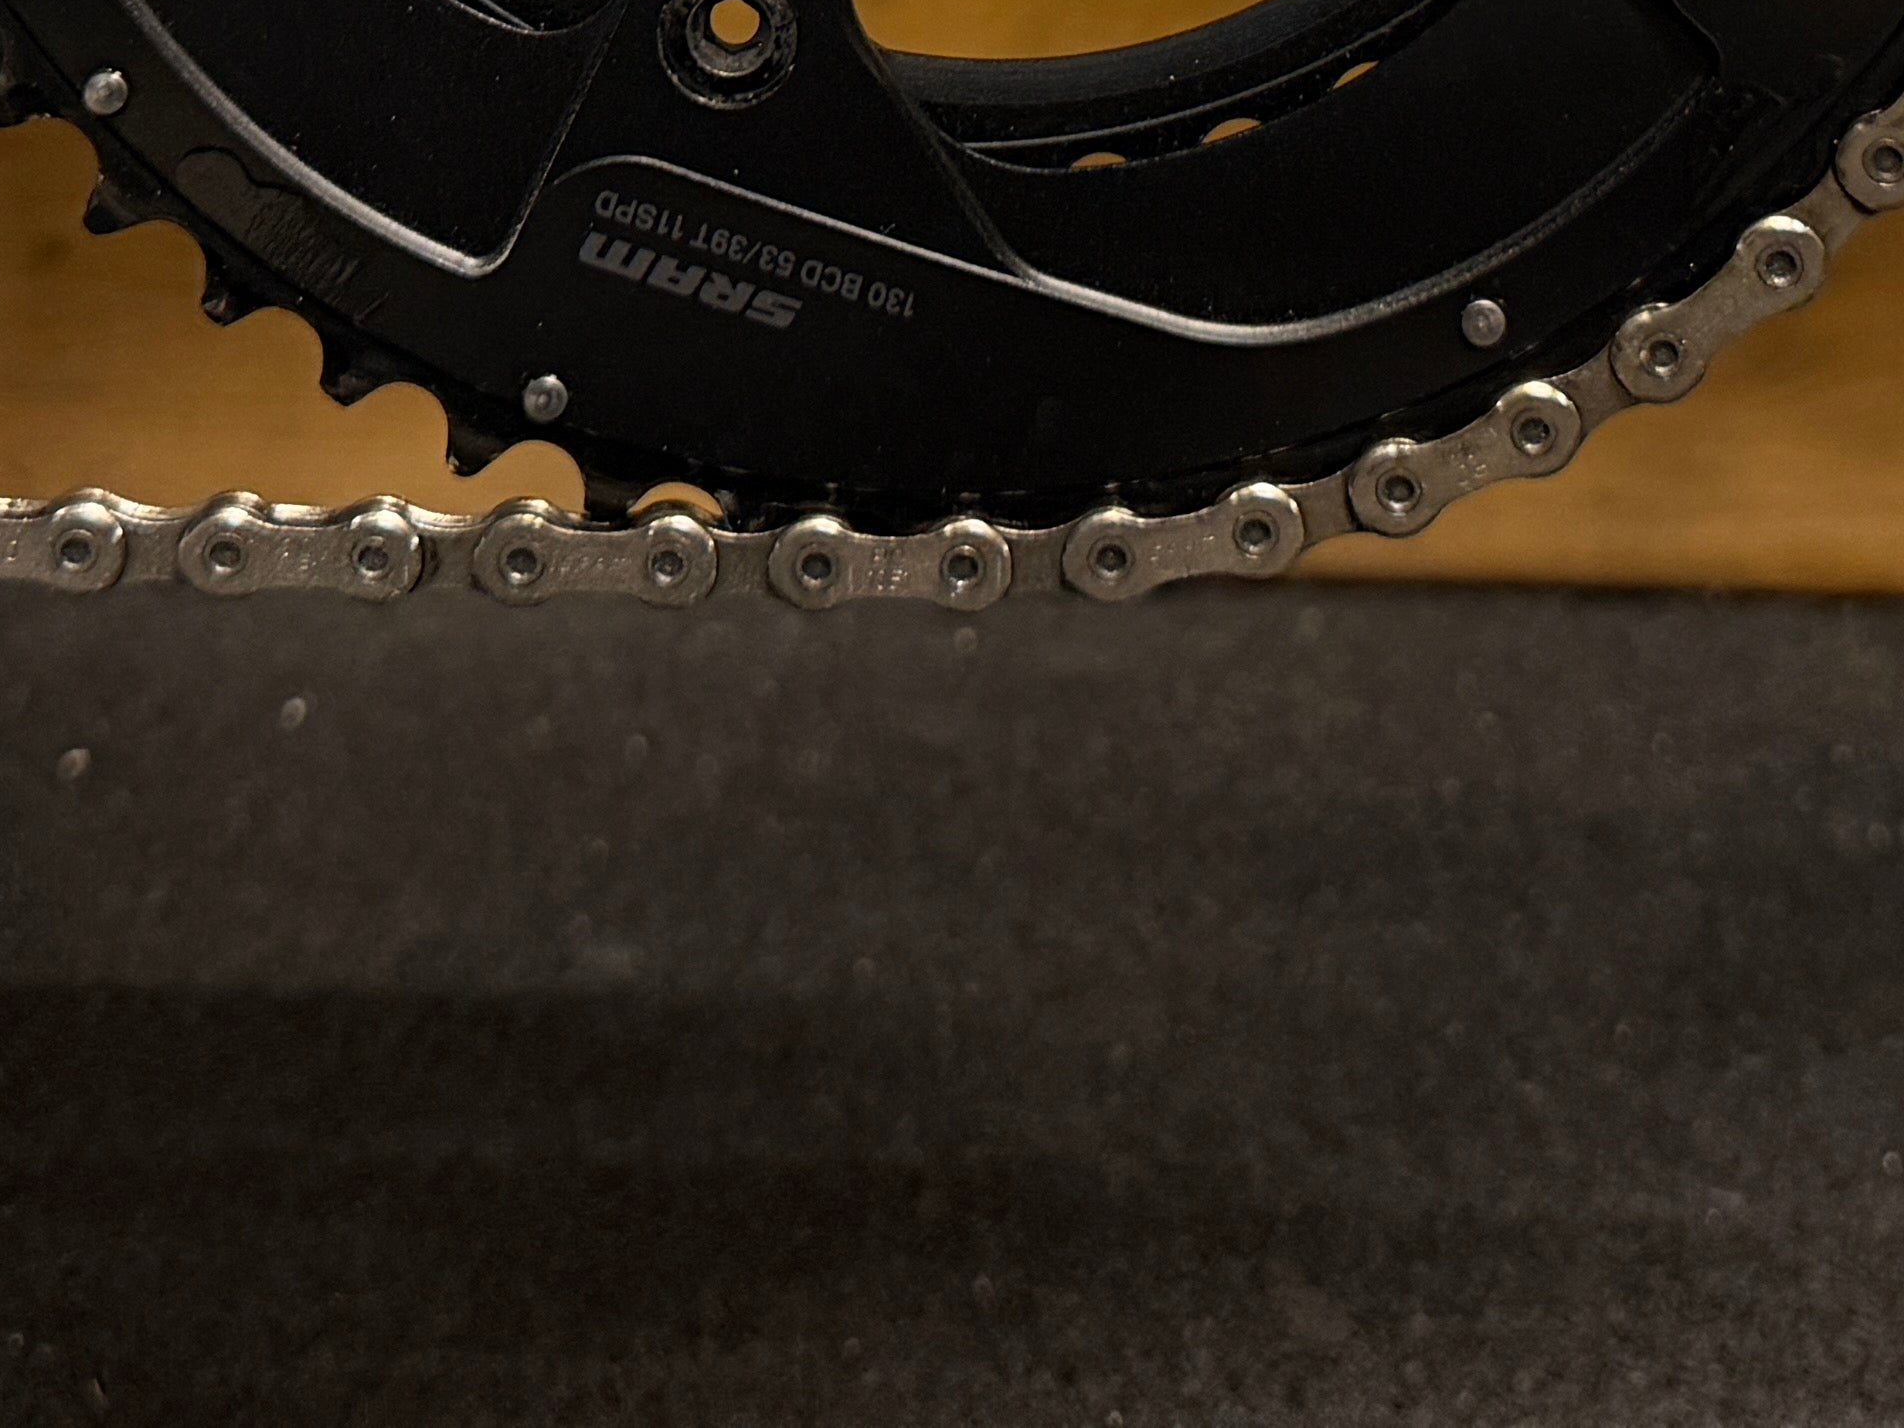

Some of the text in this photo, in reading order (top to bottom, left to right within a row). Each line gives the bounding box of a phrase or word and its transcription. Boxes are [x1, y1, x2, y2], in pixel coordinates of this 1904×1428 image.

[578, 231, 803, 329] SRAM
[800, 259, 863, 302] BCD
[867, 286, 915, 317] 130
